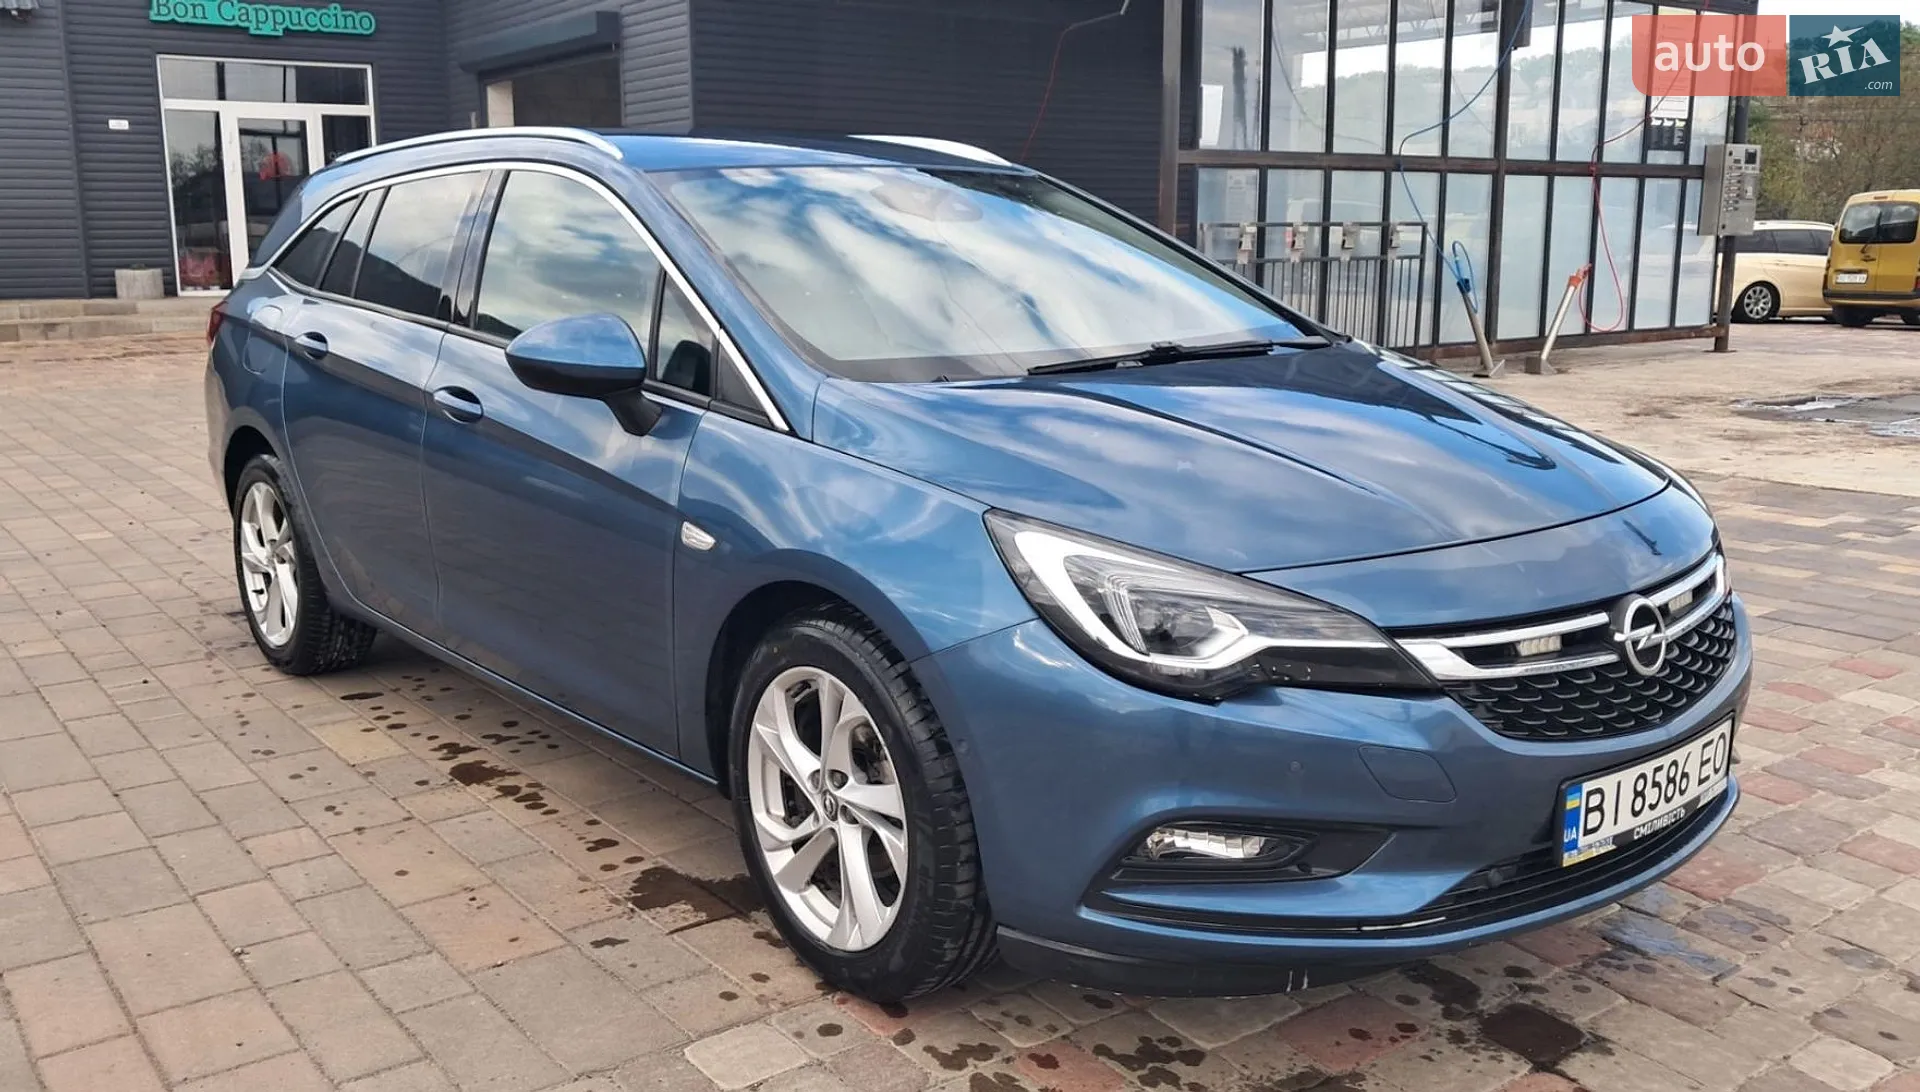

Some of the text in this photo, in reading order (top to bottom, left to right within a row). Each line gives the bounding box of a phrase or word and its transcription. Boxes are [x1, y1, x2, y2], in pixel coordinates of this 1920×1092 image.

[154, 0, 374, 32] Bon Cappuccino
[1583, 780, 1621, 837] BI
[1631, 751, 1692, 818] 8586
[1697, 731, 1727, 787] EO
[1564, 827, 1578, 843] UA
